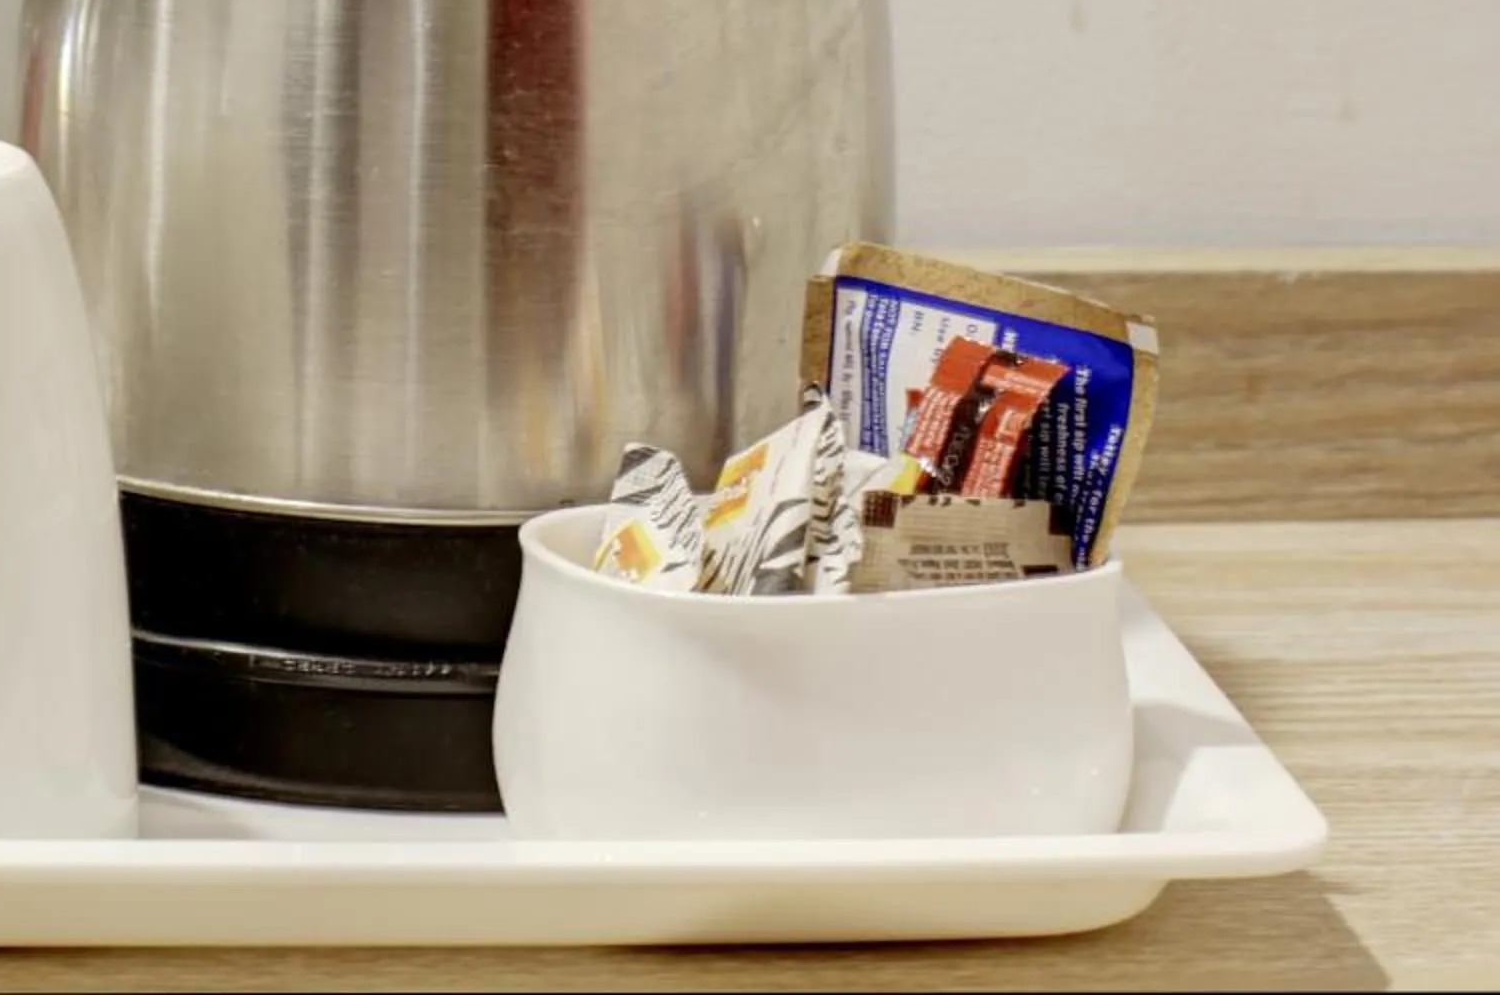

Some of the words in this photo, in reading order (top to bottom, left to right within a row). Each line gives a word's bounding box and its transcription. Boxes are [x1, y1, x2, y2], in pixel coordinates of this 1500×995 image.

[1074, 365, 1092, 396] The
[1073, 396, 1088, 428] first
[1055, 402, 1070, 472] freshness
[1071, 429, 1087, 452] sip
[1071, 452, 1085, 481] will
[1054, 473, 1068, 490] of
[1088, 488, 1102, 513] for
